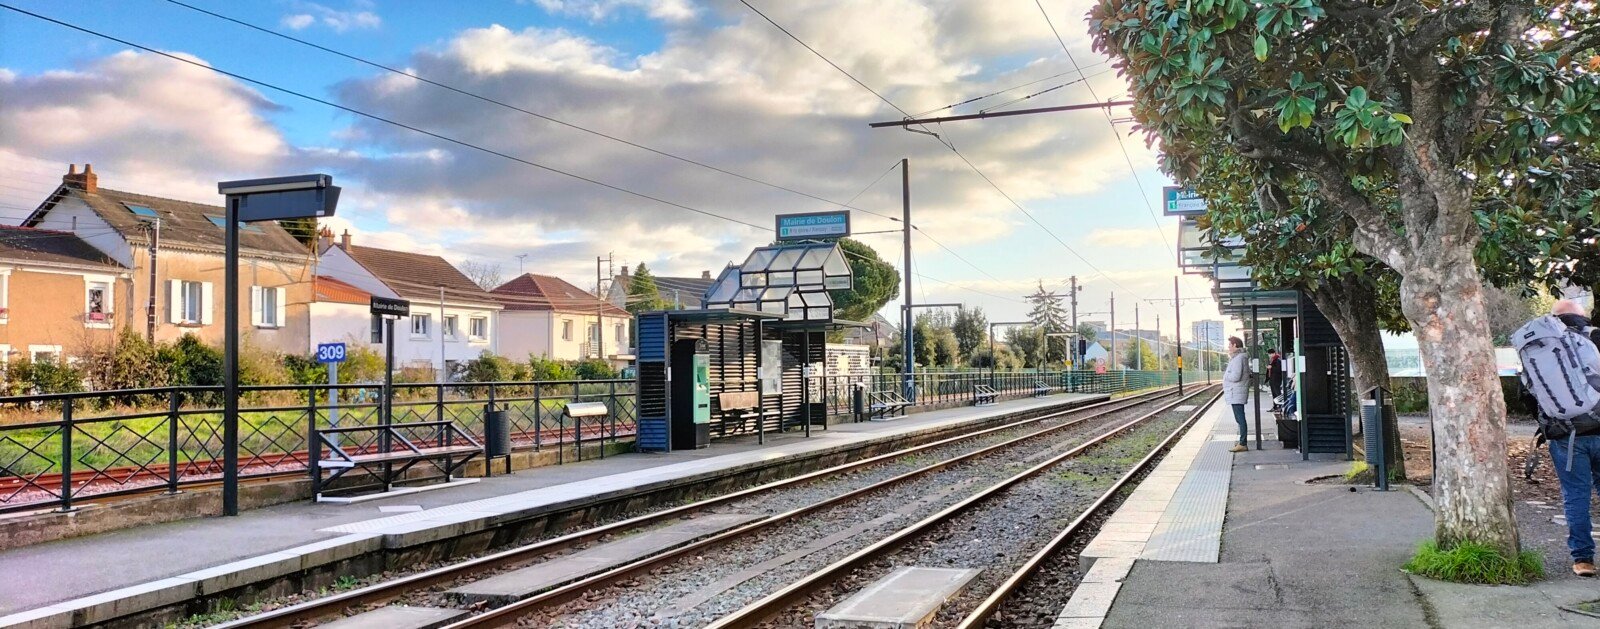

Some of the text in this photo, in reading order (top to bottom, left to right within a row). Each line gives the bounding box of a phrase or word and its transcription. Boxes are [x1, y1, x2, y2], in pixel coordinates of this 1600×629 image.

[784, 215, 842, 226] Mairie de Doulon
[320, 345, 344, 359] 309
